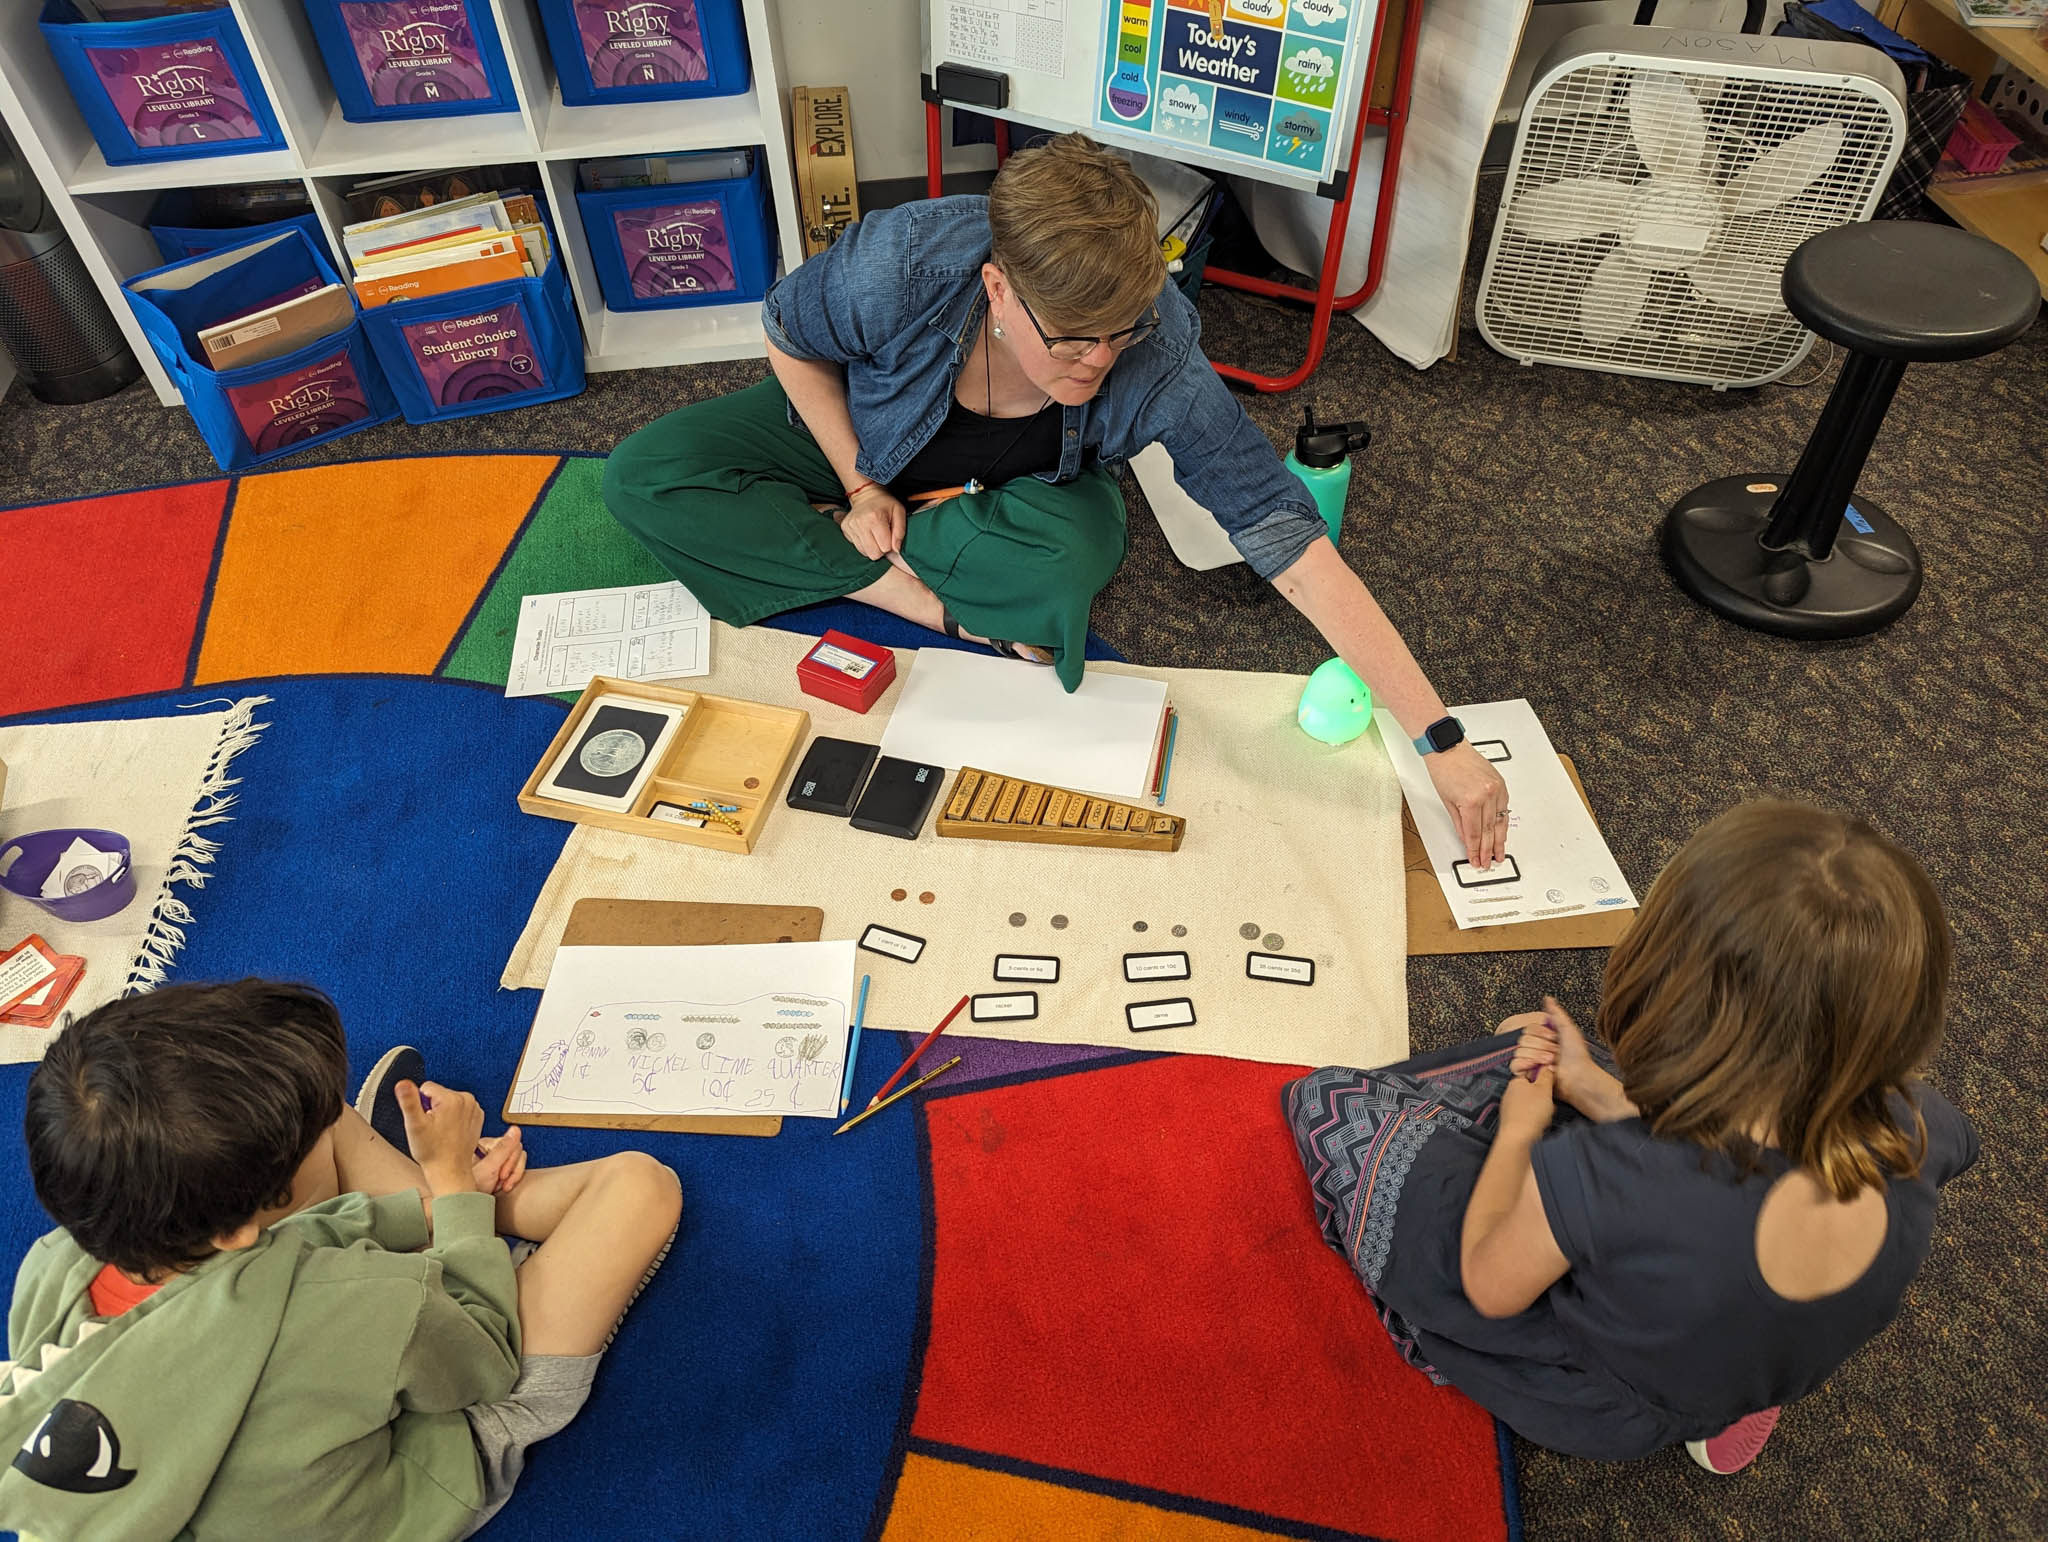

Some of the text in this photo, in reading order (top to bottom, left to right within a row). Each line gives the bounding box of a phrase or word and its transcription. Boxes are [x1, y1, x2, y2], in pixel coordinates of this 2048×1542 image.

[1242, 0, 1273, 17] cloudy
[1302, 0, 1334, 16] cloudy
[604, 8, 668, 37] Rigby
[1123, 15, 1148, 27] warm
[380, 27, 446, 55] Rigby
[610, 39, 672, 50] LEVELED LIBRARY
[1187, 22, 1257, 57] Today's
[1124, 42, 1142, 54] cool
[1662, 35, 1816, 67] MASON
[388, 57, 453, 68] LEVELED LIBRARY
[1178, 47, 1260, 84] Weather
[1298, 58, 1322, 73] rainy
[644, 69, 655, 81] N
[1121, 72, 1139, 83] cold
[132, 70, 208, 98] Rigby
[424, 86, 440, 98] M
[147, 97, 216, 112] LEVELED LIBRARY
[1112, 93, 1143, 111] freezing
[1168, 97, 1197, 113] snowy
[1225, 109, 1251, 124] windy
[193, 126, 206, 138] L
[814, 94, 846, 157] EXPLORE.
[1285, 121, 1315, 136] stormy
[646, 226, 702, 252] Rigby
[649, 252, 705, 263] LEVELED LIBRARY
[388, 280, 420, 293] Reading
[672, 276, 697, 289] L-Q
[455, 313, 498, 329] Reading
[422, 329, 518, 356] Student Choice
[450, 346, 499, 363] Library
[267, 384, 332, 416] Rigby
[274, 401, 337, 426] LEVELED LIBRARY
[309, 426, 320, 434] P
[628, 1053, 689, 1074] NICKEL
[702, 1052, 755, 1075] DIME
[632, 1072, 657, 1095] 5¢
[702, 1078, 735, 1102] 10¢
